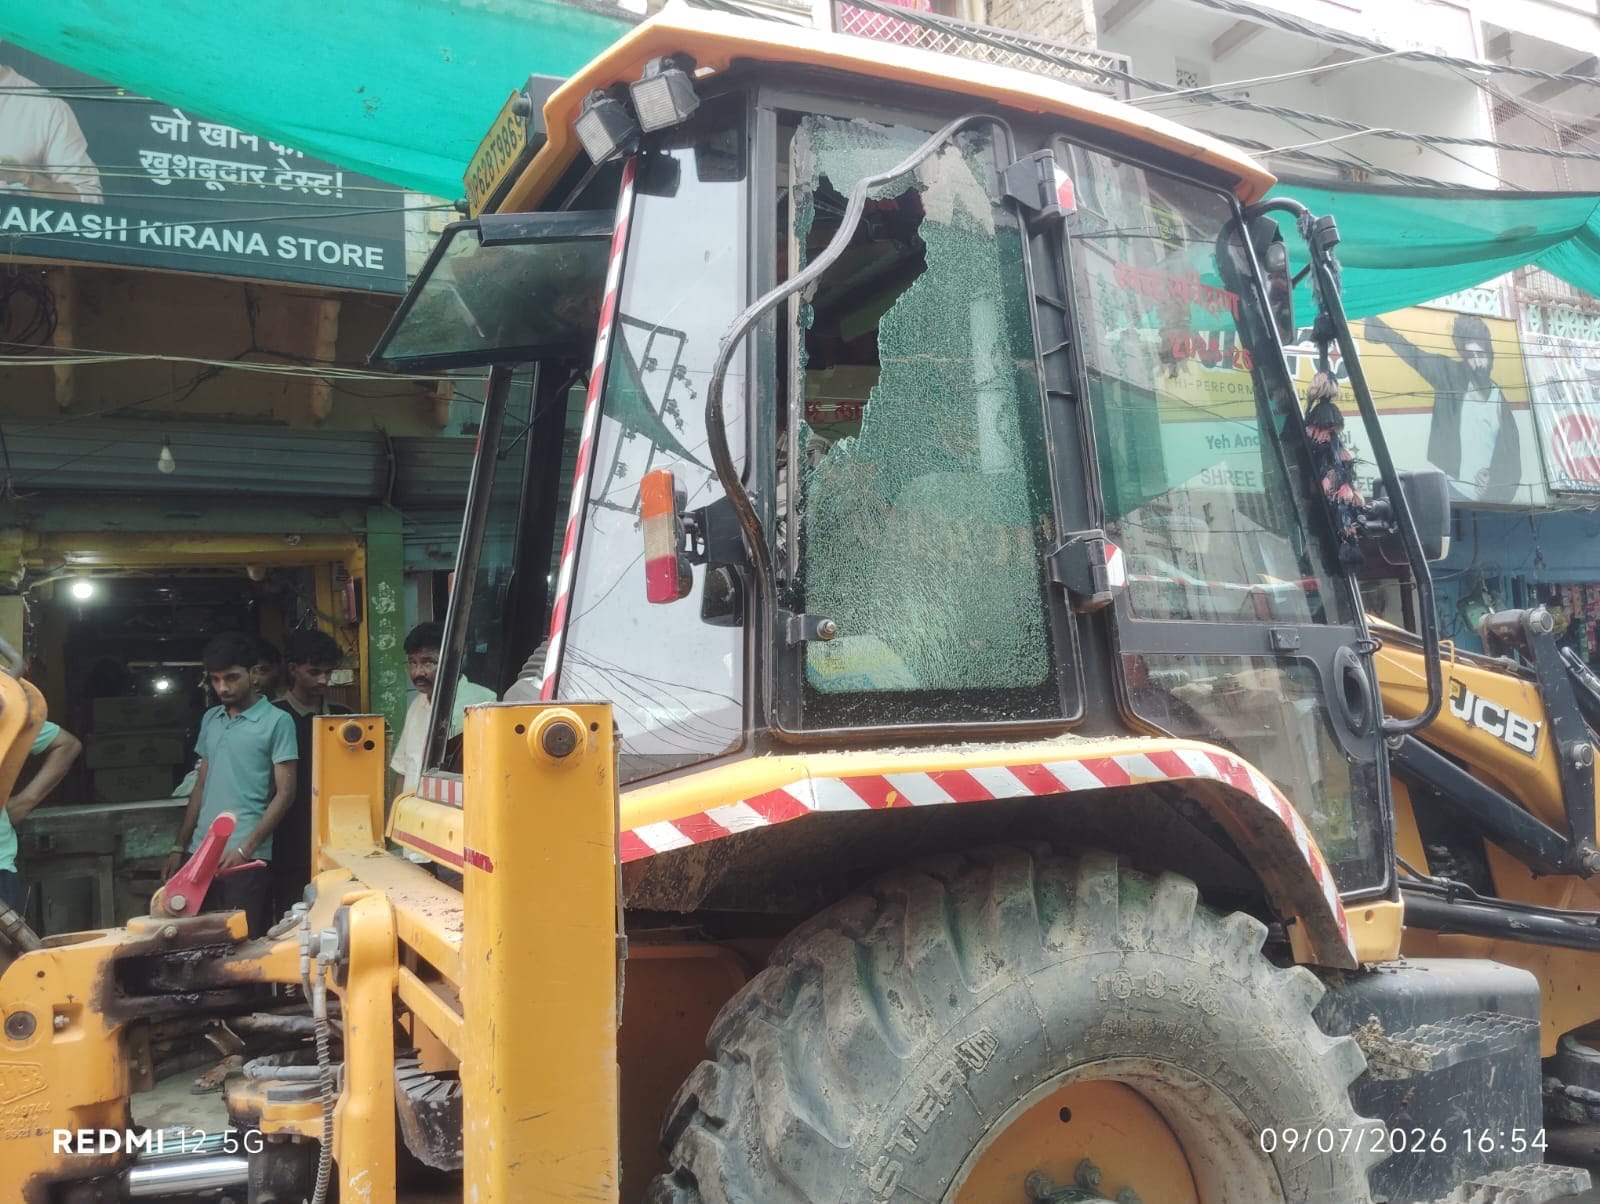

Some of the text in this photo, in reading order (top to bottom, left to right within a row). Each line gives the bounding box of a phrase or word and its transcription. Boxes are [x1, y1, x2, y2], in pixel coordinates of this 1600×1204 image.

[149, 108, 192, 143] जो
[138, 149, 268, 192] खुशबूदार
[0, 206, 385, 270] AKASH KIRANA STORE
[1205, 433, 1231, 449] Yeh
[1199, 467, 1257, 488] SHREE
[1450, 690, 1536, 753] JCB
